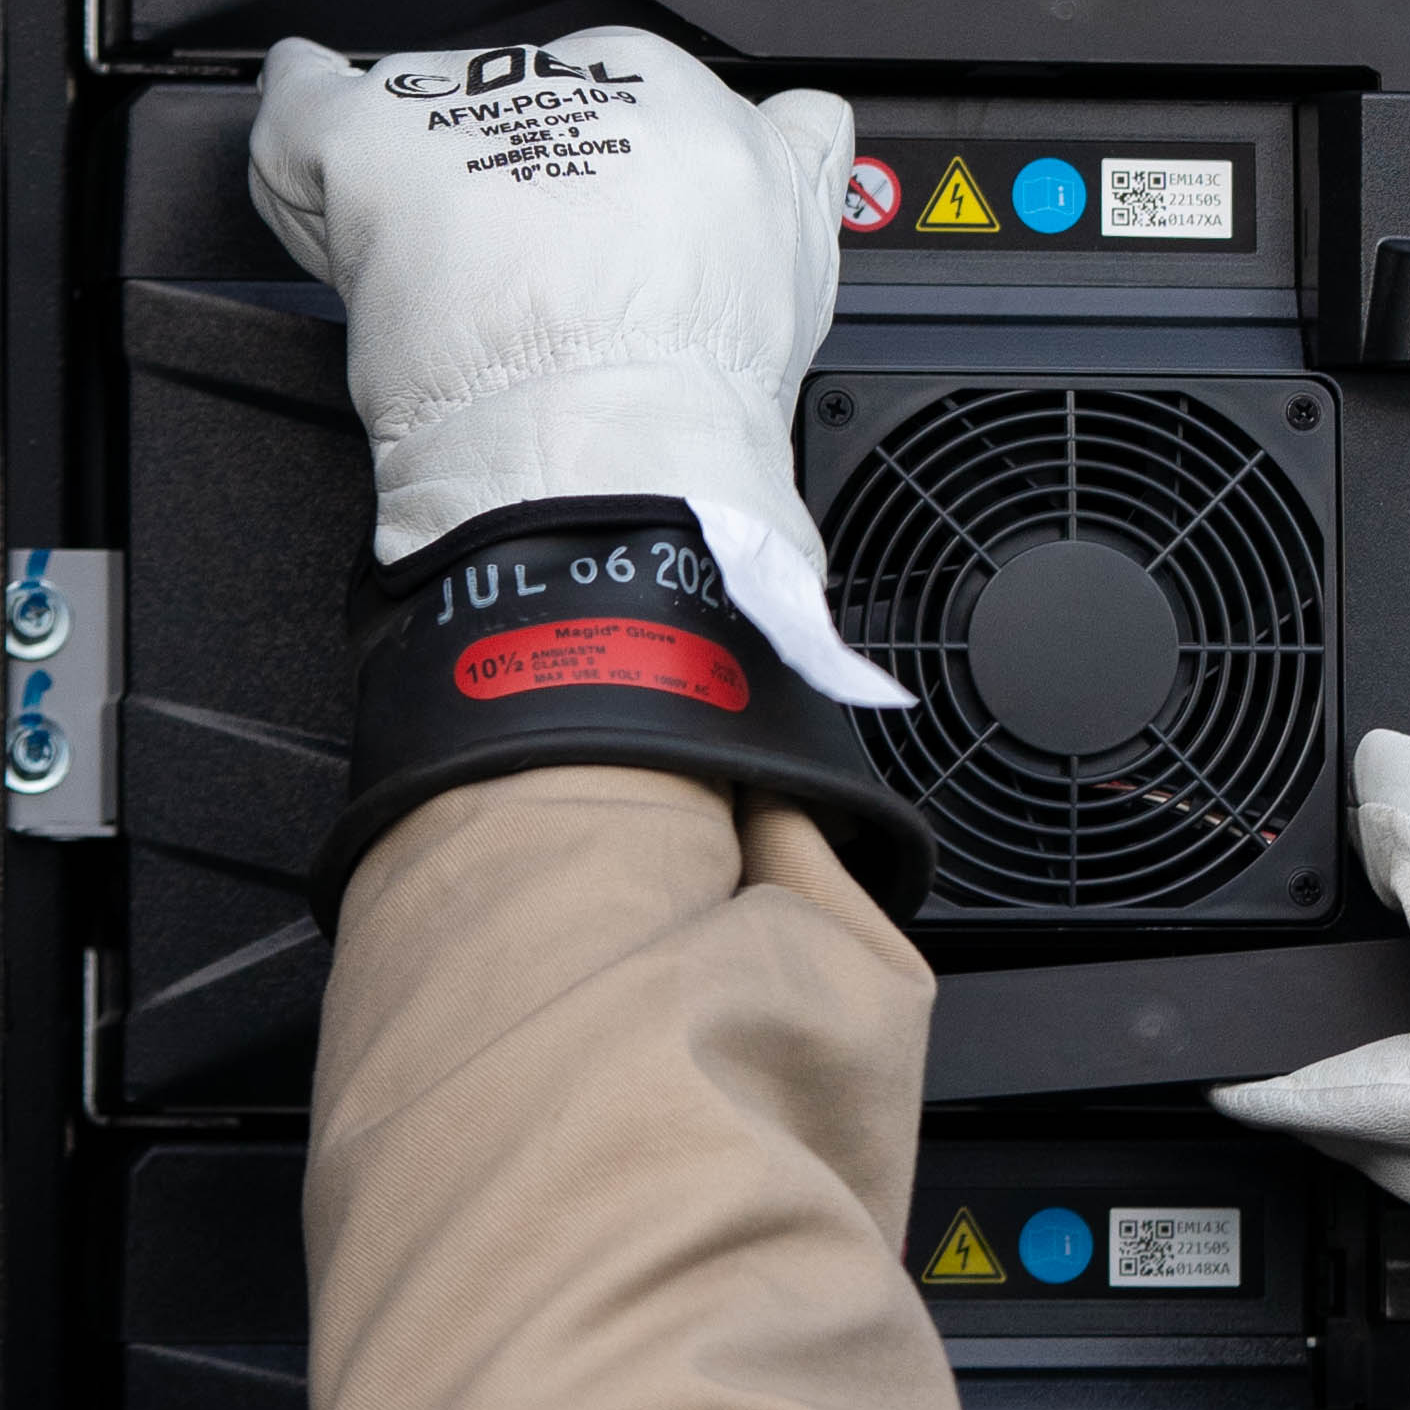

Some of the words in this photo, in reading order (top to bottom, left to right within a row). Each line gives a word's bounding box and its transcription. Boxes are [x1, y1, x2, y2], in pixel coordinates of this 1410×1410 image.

[428, 88, 637, 130] AFW-PG-10-9
[480, 118, 540, 136] WEAR
[544, 111, 599, 126] OVER
[510, 129, 554, 145] SIZE
[568, 127, 580, 138] 9
[467, 145, 548, 173] RUBBER
[553, 138, 631, 157] GLOVES
[1169, 173, 1222, 186] EM143C
[1169, 194, 1221, 206] 221505
[1168, 214, 1223, 226] 0147XA
[436, 564, 547, 626] JUL
[626, 625, 677, 645] Glove
[1177, 1221, 1230, 1234] EM143C
[1177, 1242, 1230, 1255] 221505
